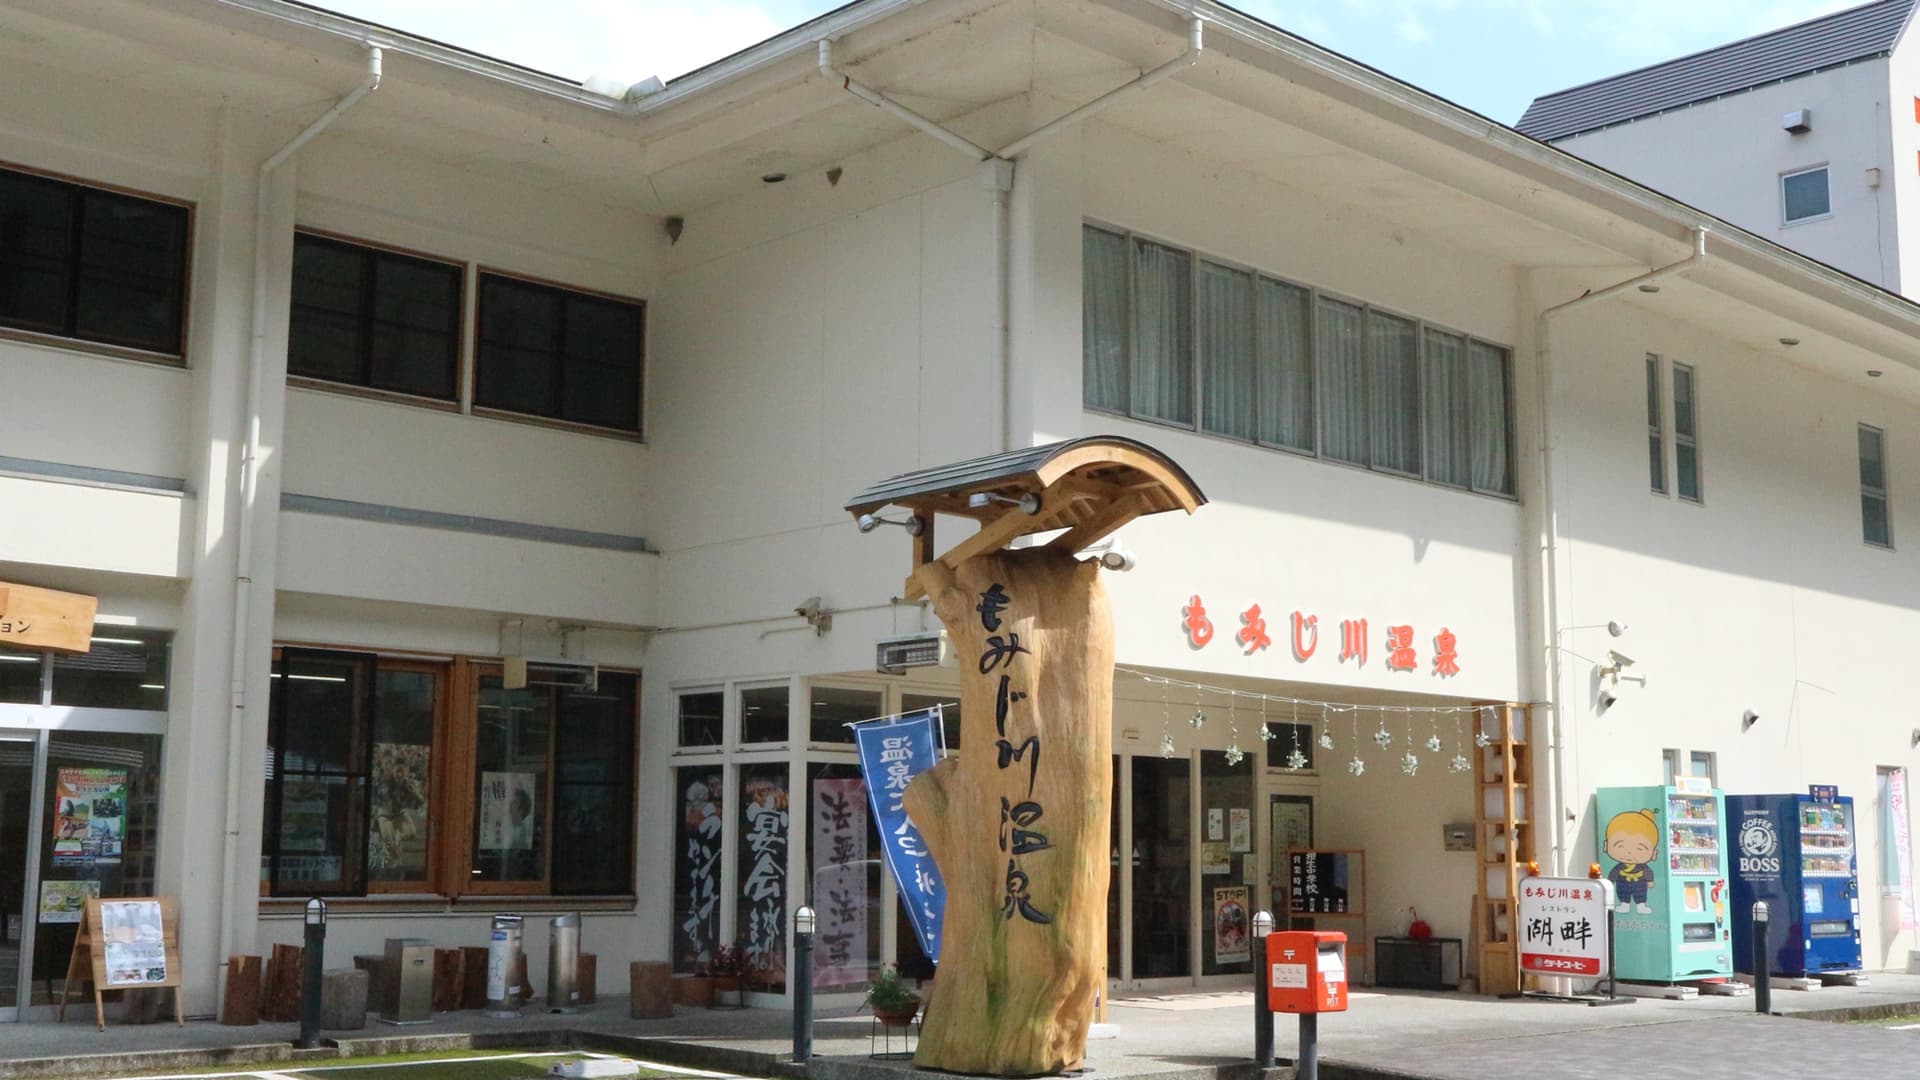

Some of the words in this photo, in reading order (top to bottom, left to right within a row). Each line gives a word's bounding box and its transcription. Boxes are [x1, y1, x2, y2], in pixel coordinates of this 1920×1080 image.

[0, 615, 32, 634] ョン
[1182, 594, 1460, 678] もみじ川温泉
[976, 583, 1056, 925] もみじ川温泉
[1742, 818, 1773, 831] COFFEE
[744, 795, 790, 902] 宴会
[1739, 857, 1780, 872] BOSS
[1216, 889, 1247, 901] STOP!
[1526, 886, 1593, 901] もみじ川温泉
[1541, 905, 1577, 913] レストラン
[1527, 916, 1593, 950] 湖畔
